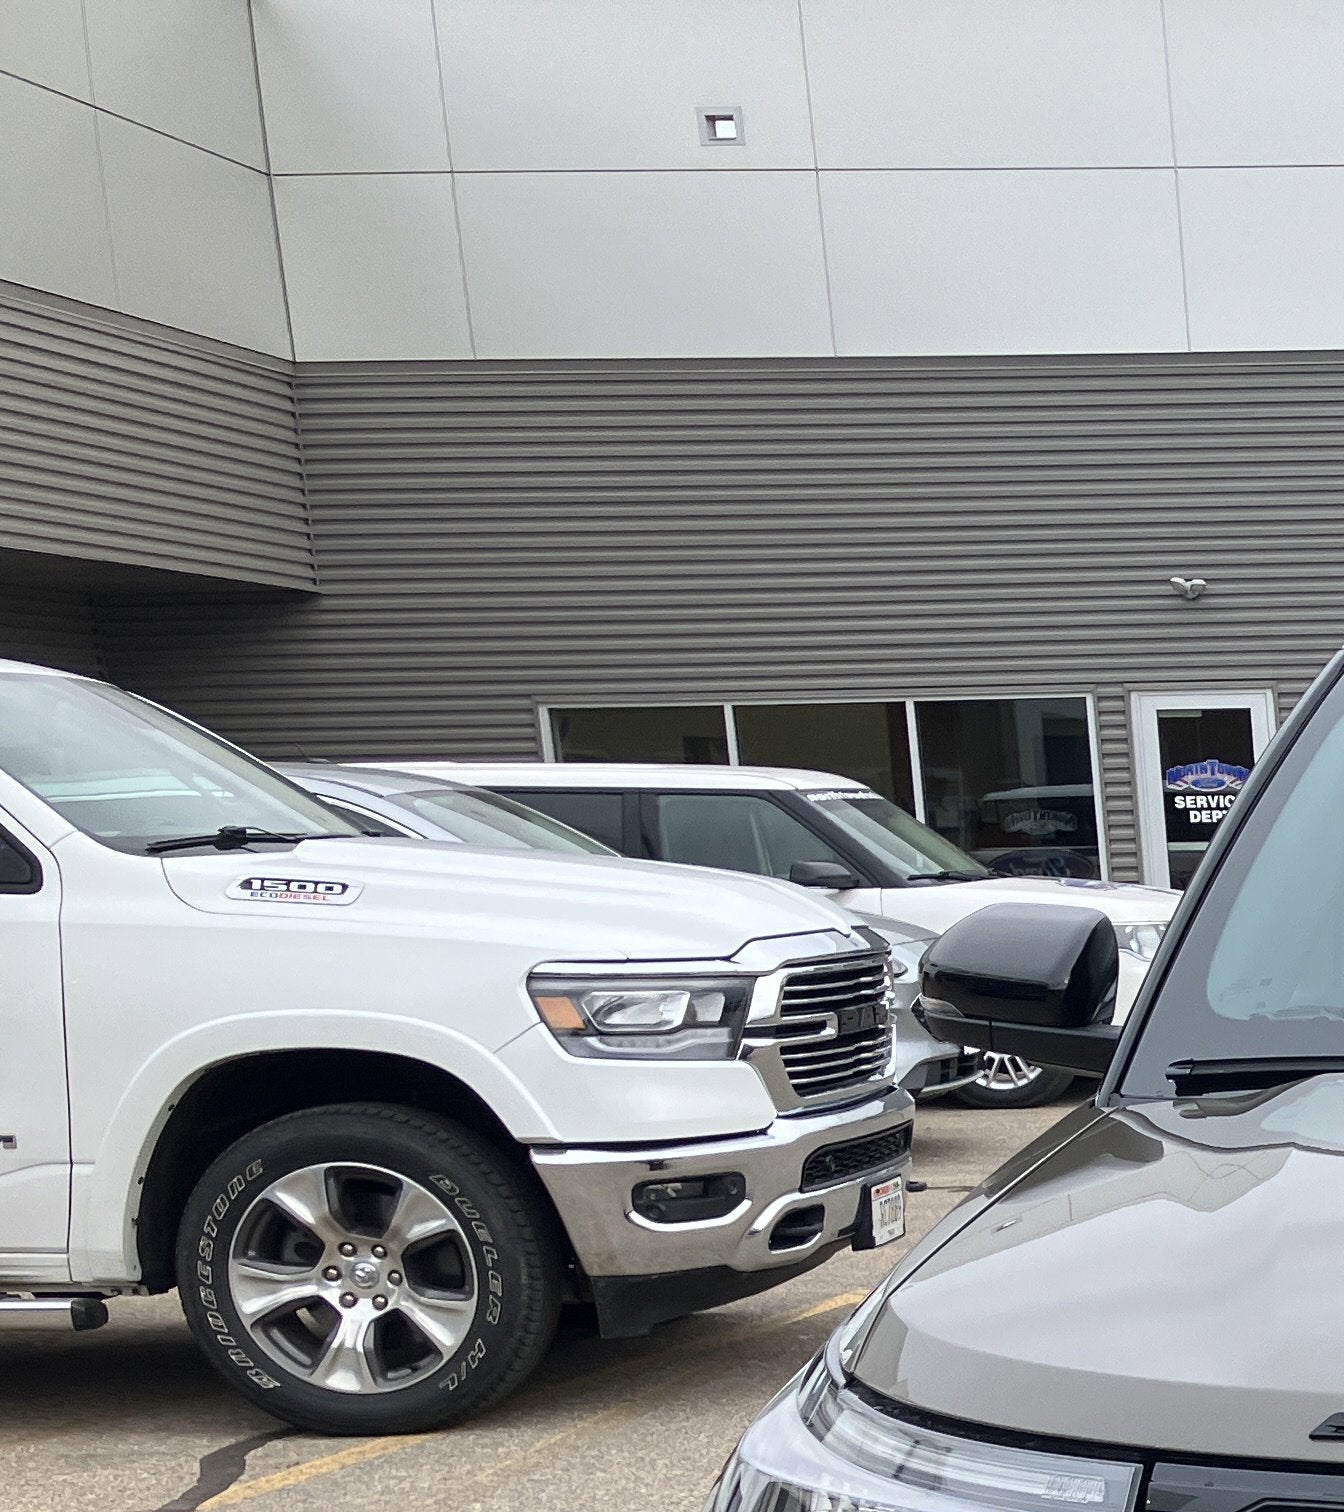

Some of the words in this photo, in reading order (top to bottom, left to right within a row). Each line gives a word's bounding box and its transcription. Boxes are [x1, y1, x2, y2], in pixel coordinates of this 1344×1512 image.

[1174, 795, 1236, 809] SERVIC
[1189, 810, 1228, 823] DEP
[250, 879, 343, 894] 1500
[250, 891, 330, 901] ECODIESEL
[429, 1174, 503, 1326] DUELER
[197, 1159, 281, 1389] BRIDGESTONE
[439, 1338, 487, 1391] H/L
